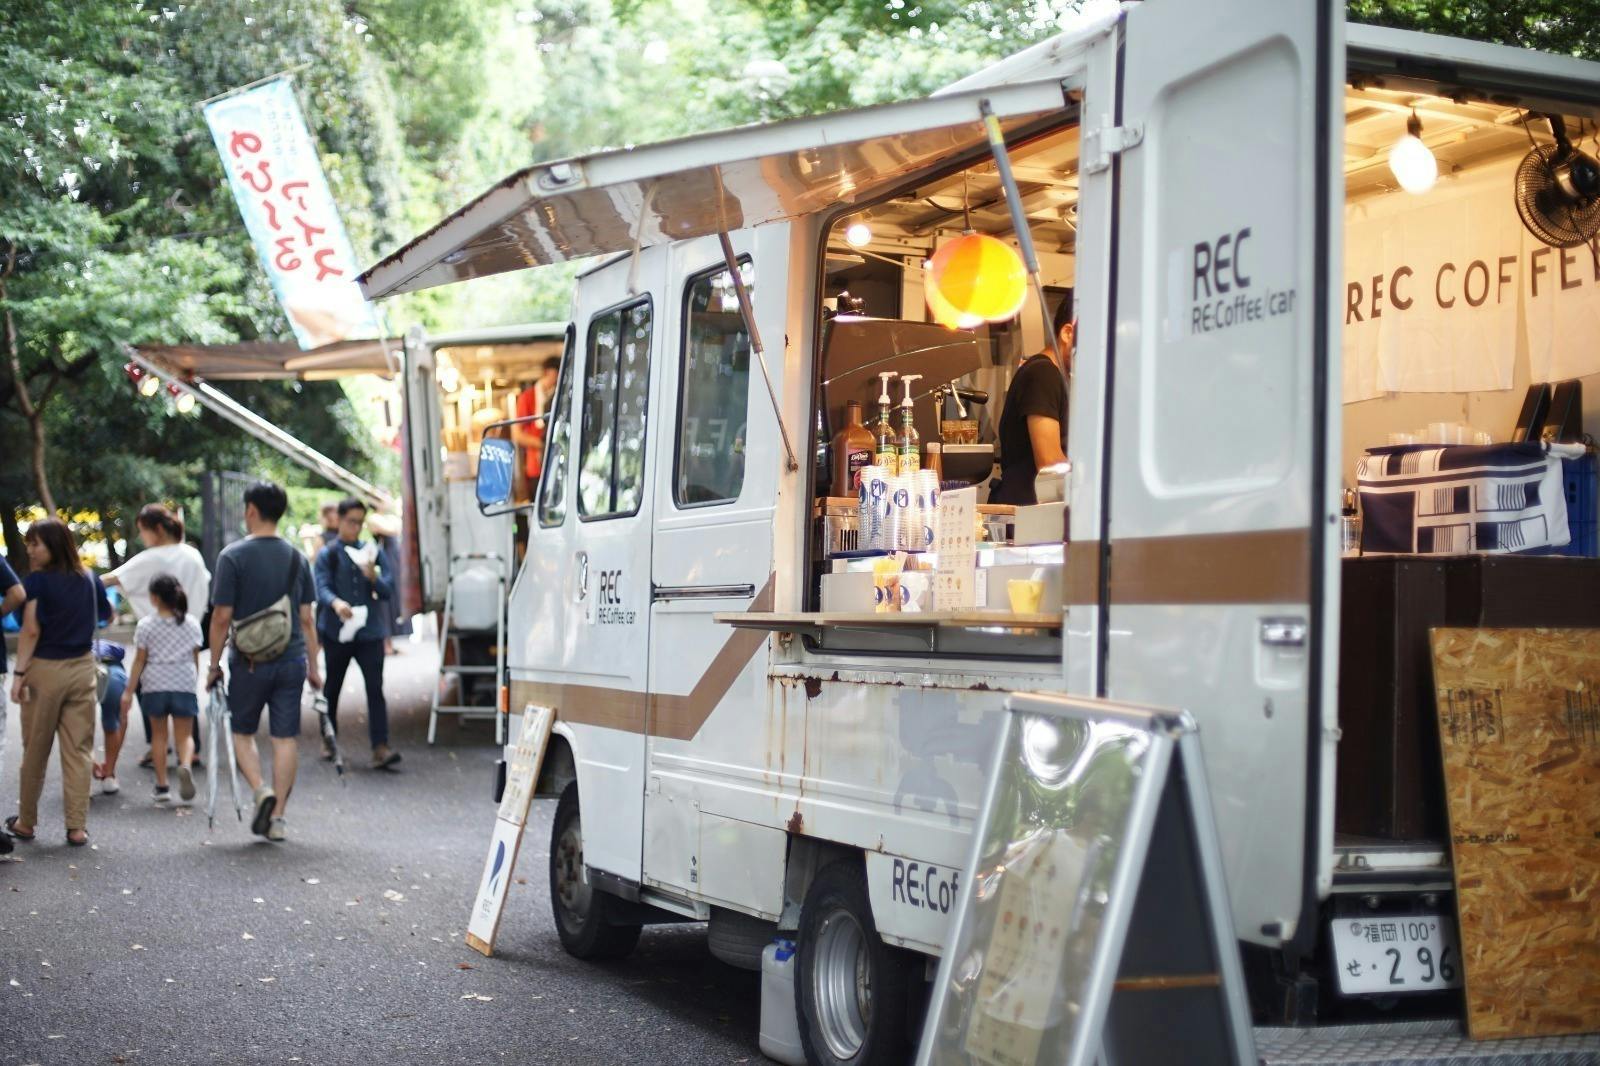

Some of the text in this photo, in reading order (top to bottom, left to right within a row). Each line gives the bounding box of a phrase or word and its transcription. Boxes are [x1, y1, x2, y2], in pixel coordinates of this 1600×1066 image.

[1193, 226, 1252, 302] REC
[1346, 265, 1415, 325] REC
[599, 569, 622, 605] REC
